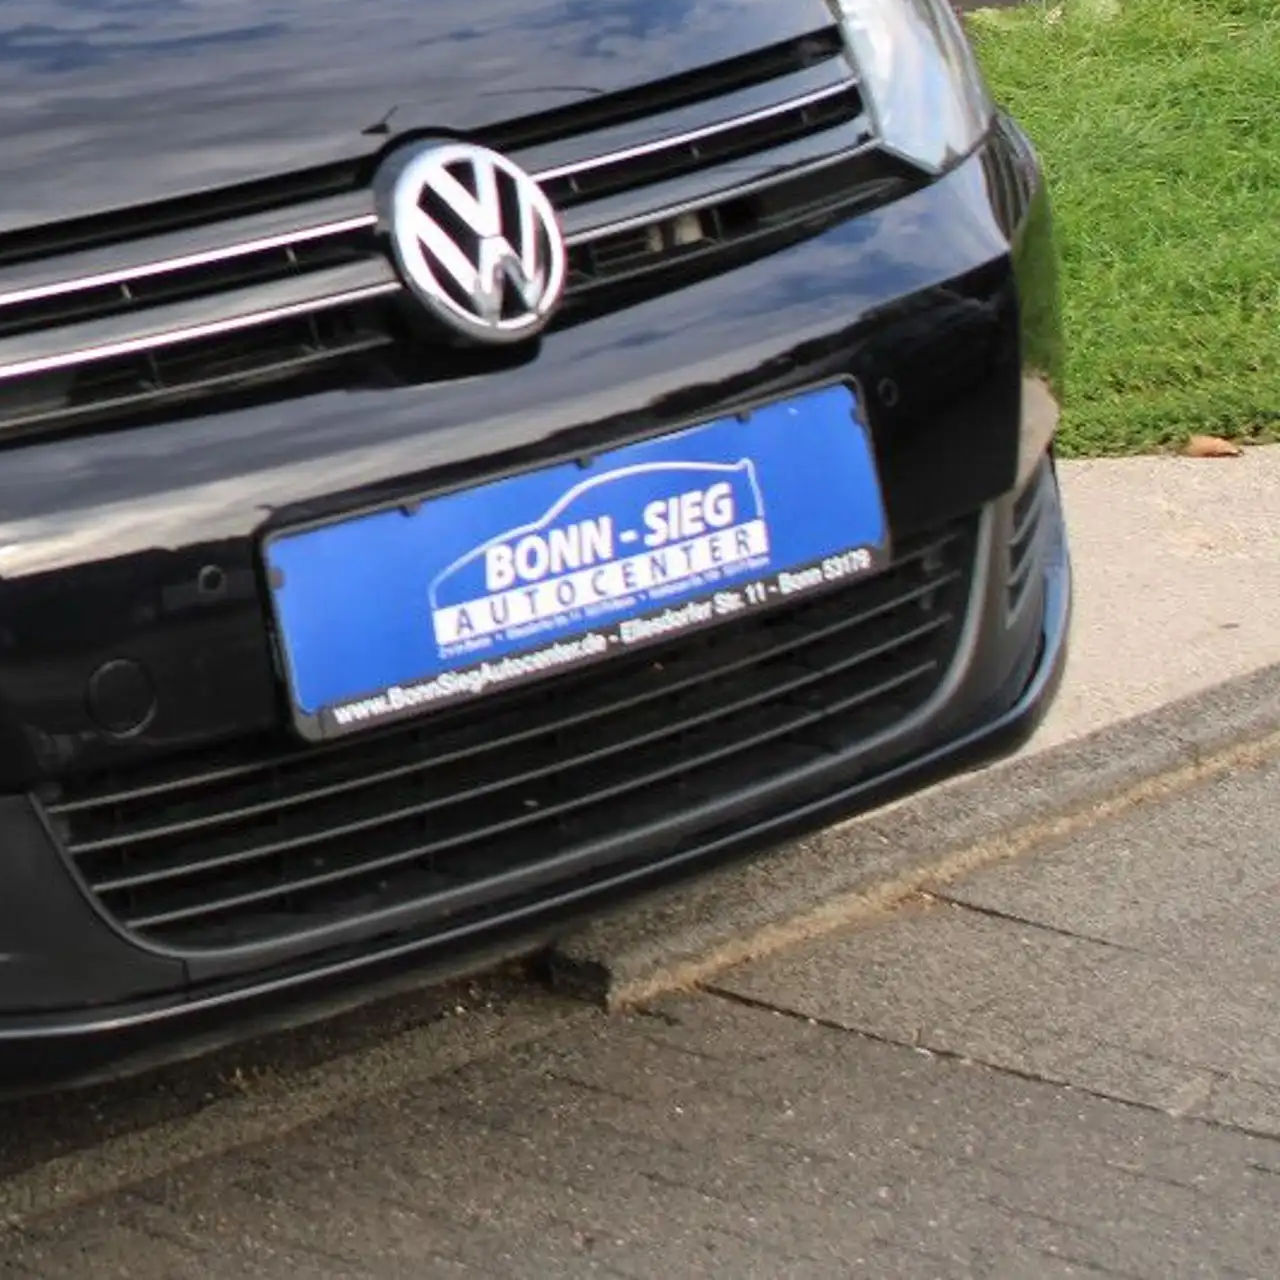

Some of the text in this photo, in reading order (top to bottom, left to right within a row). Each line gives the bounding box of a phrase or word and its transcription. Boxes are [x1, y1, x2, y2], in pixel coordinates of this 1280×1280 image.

[453, 528, 756, 636] AUTOCENTER
[484, 515, 614, 591] BONN
[643, 481, 733, 548] SIEG
